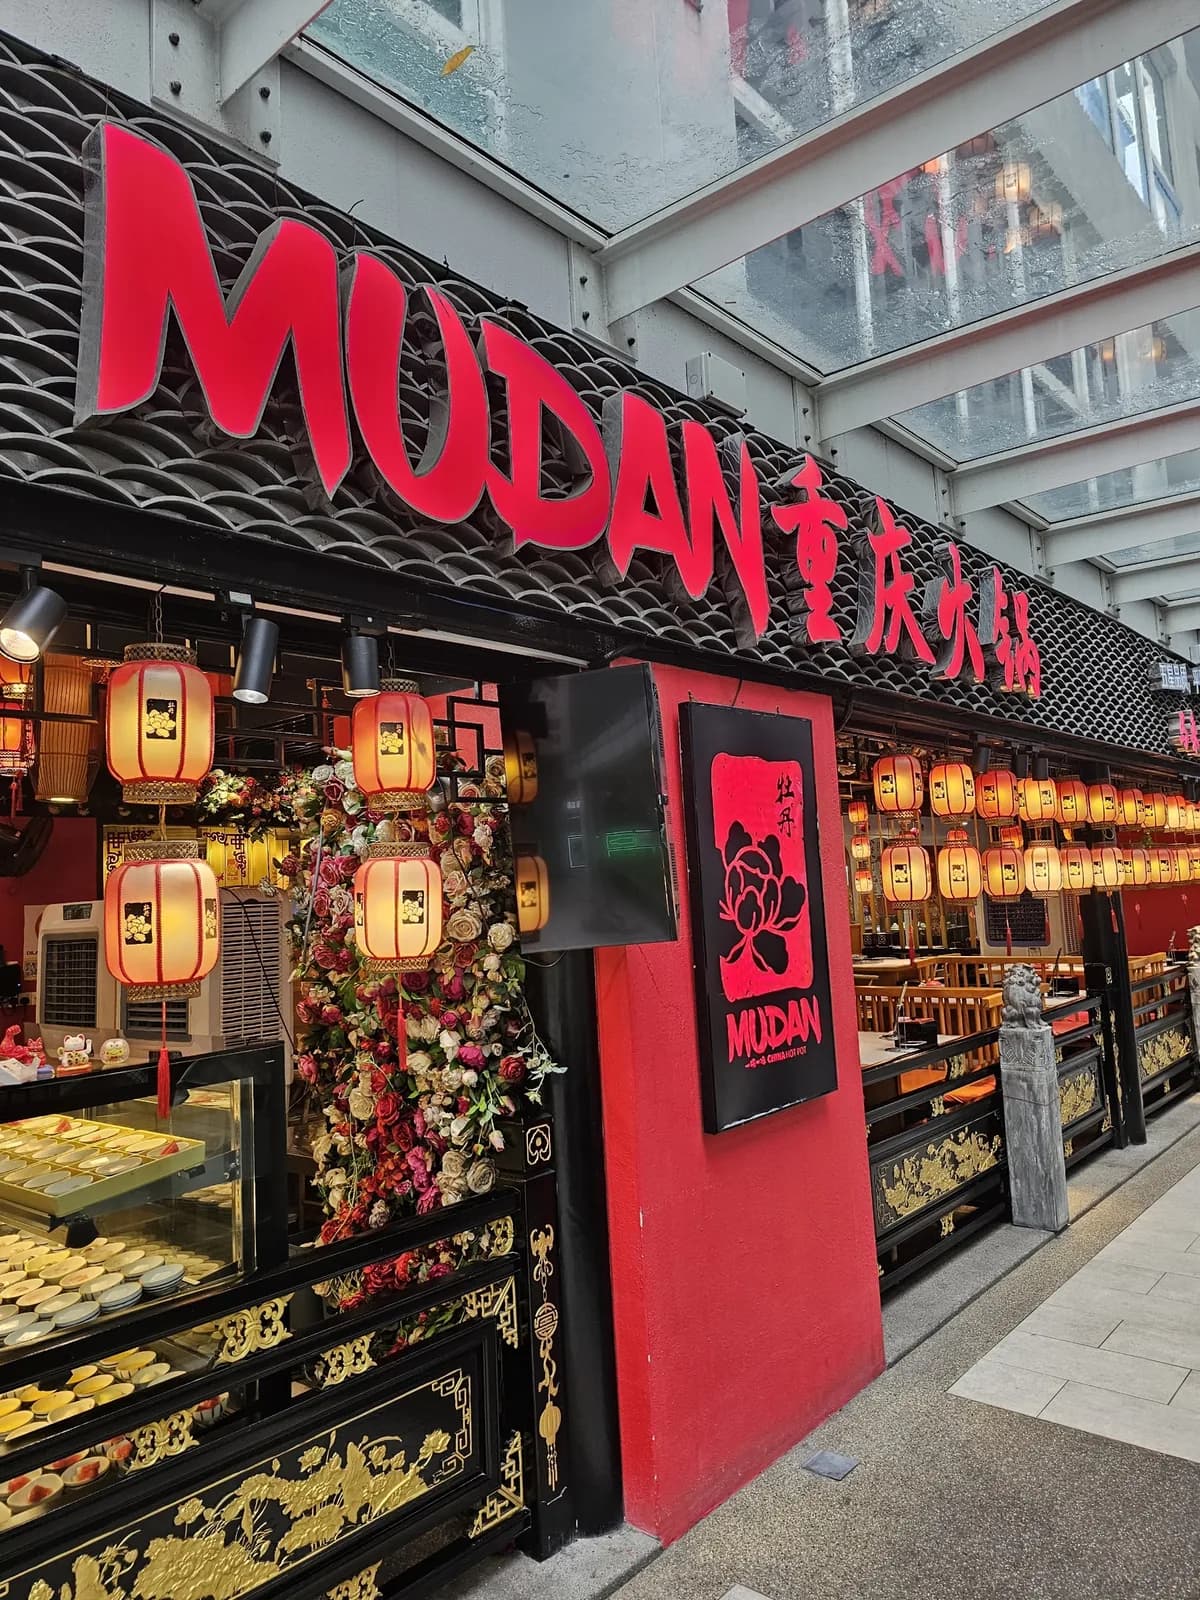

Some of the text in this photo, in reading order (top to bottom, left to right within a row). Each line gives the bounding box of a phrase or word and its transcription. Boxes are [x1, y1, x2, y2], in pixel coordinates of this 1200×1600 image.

[95, 121, 770, 640] MUDAN
[771, 453, 1041, 699] 重庆火锅
[775, 772, 796, 838] 牡丹
[725, 994, 823, 1064] MUDAN
